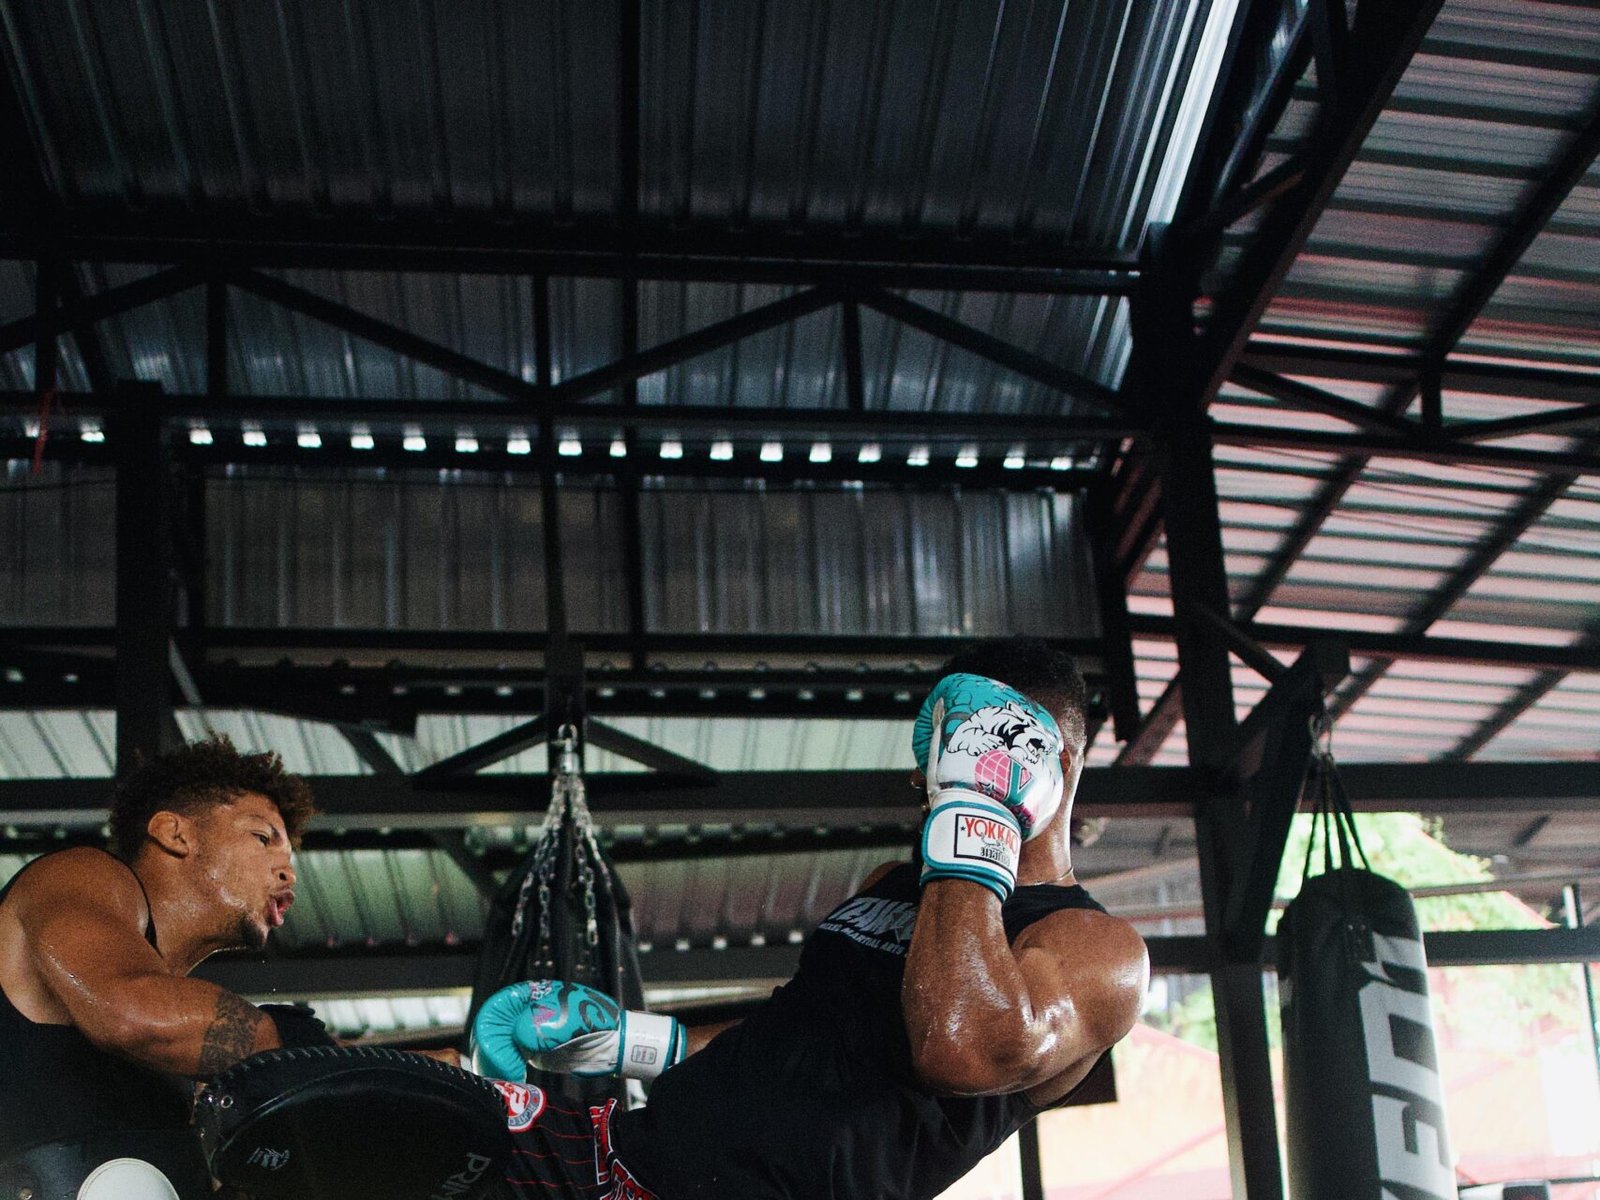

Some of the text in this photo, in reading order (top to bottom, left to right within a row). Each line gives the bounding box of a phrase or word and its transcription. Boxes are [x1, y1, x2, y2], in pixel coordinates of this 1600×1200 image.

[964, 816, 1019, 856] YOKKAO
[842, 927, 881, 949] MARTIAL
[879, 942, 906, 955] ARTS
